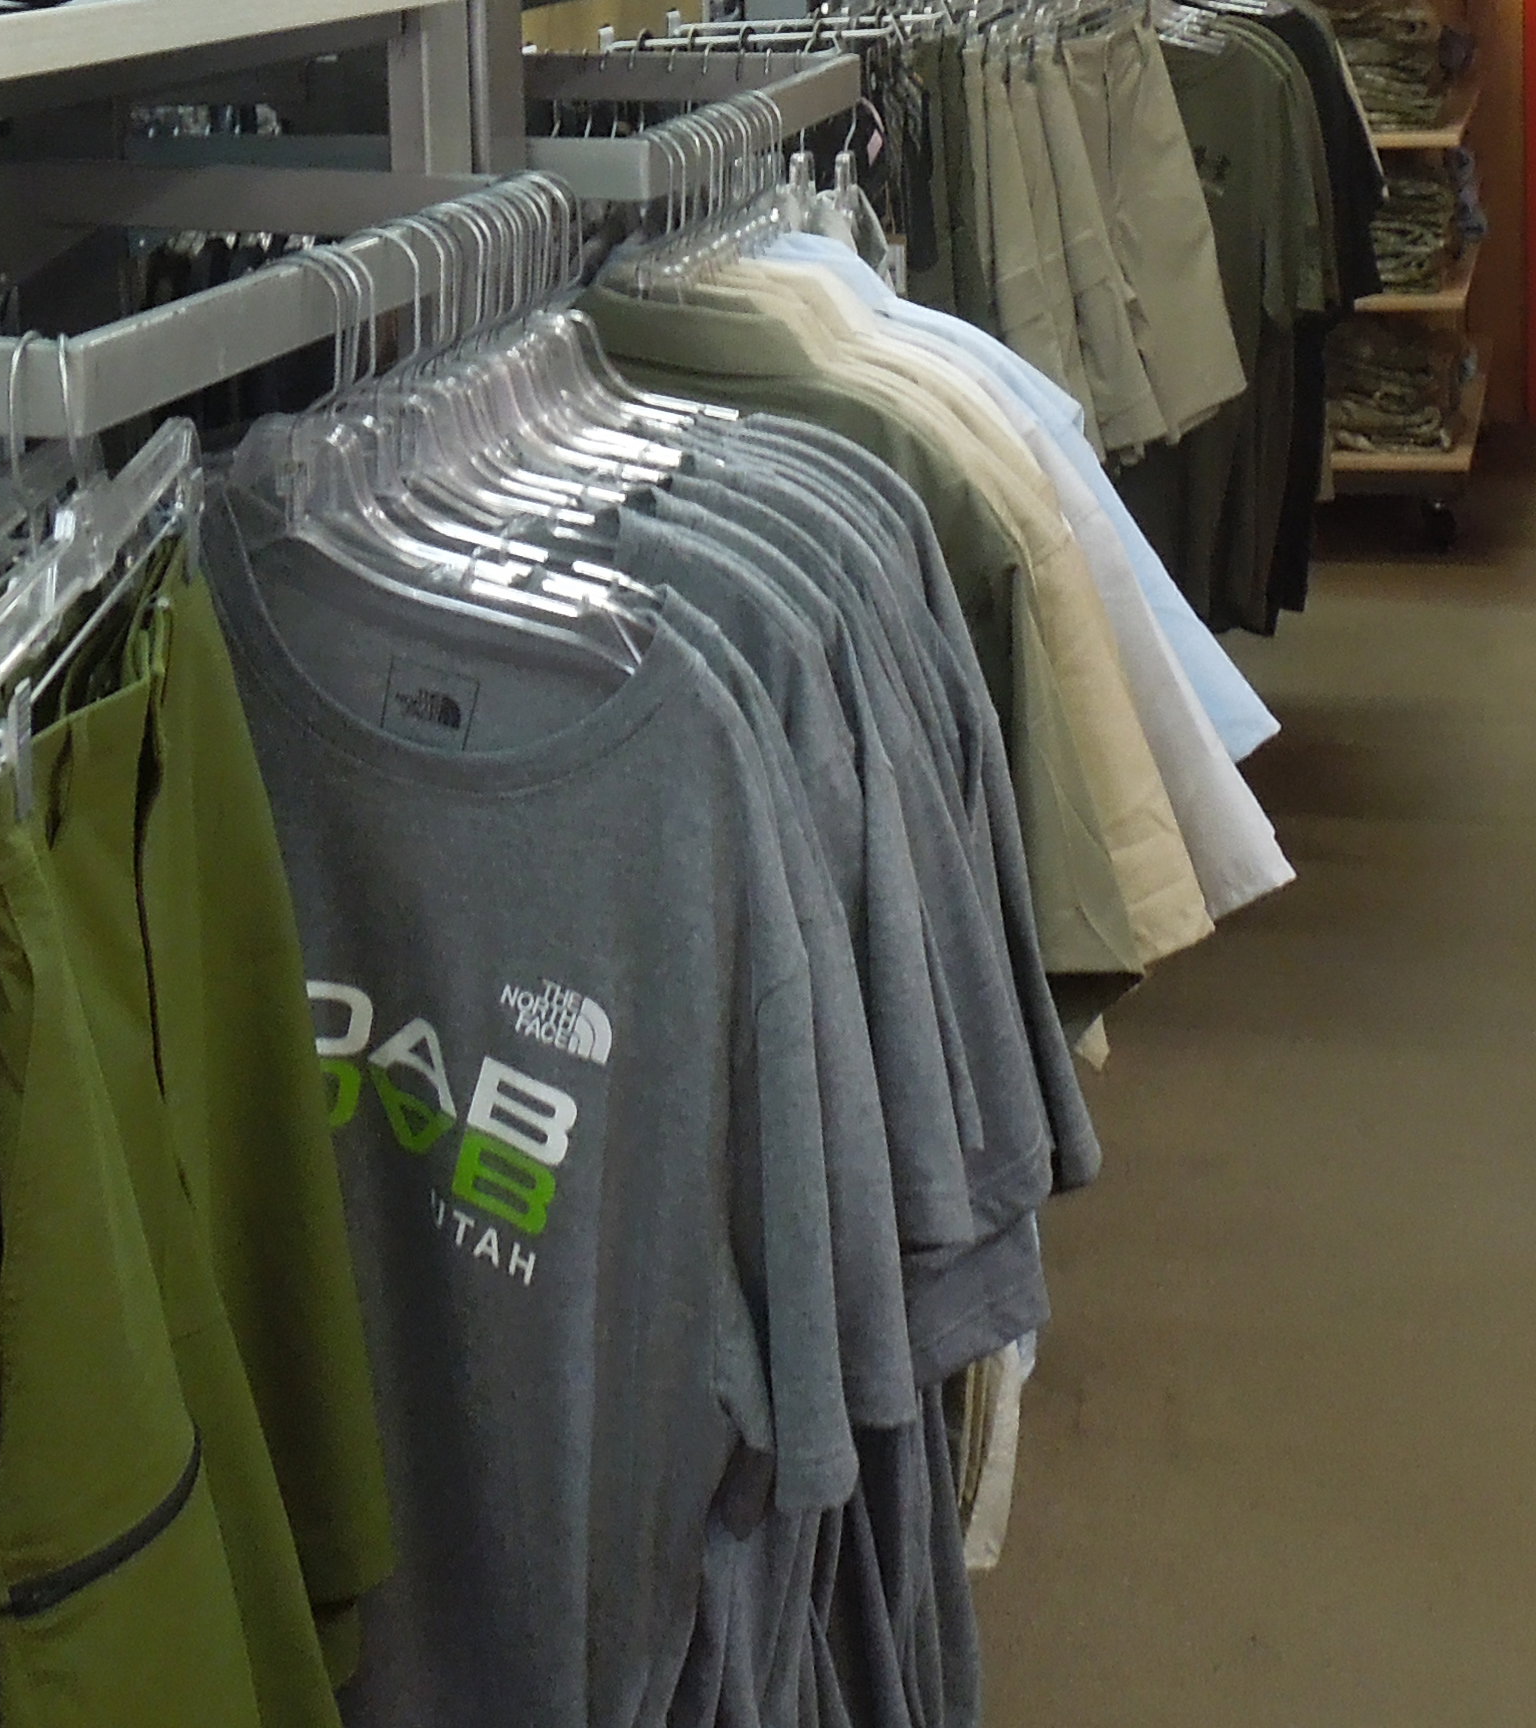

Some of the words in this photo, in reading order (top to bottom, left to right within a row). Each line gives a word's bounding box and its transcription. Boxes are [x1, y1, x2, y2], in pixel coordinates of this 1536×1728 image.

[500, 983, 578, 1035] NORTH
[543, 978, 584, 1013] THE
[514, 1011, 570, 1051] FACE
[306, 980, 578, 1166] OAB
